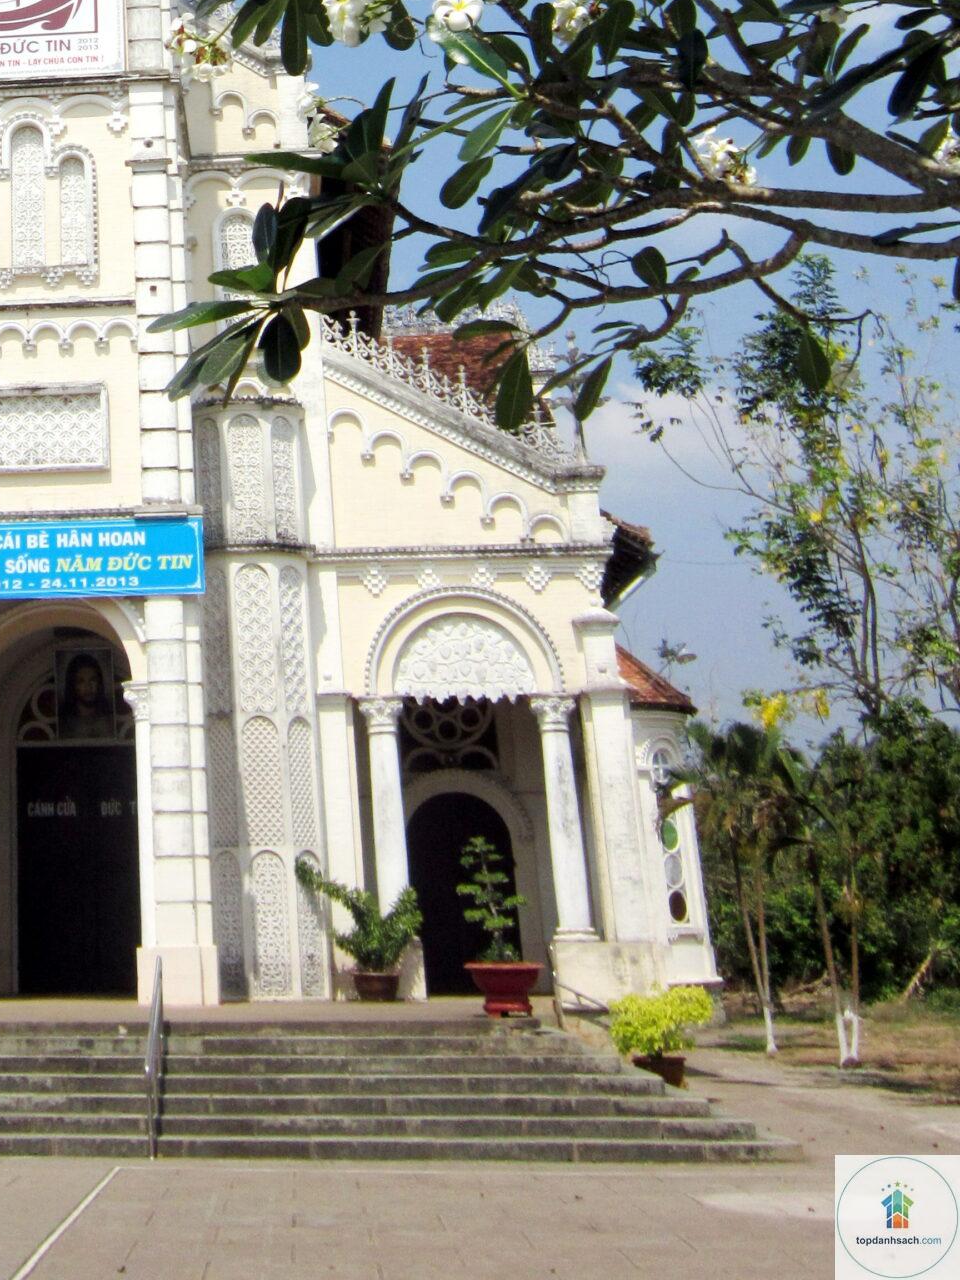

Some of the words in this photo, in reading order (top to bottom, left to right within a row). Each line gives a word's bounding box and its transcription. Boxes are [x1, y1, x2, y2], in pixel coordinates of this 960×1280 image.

[0, 38, 40, 55] ĐỨC
[45, 39, 71, 52] TIN
[77, 37, 99, 45] 2012
[7, 58, 21, 67] TIN
[67, 55, 83, 64] CON
[26, 530, 49, 549] BÈ
[56, 529, 93, 548] HÂN
[98, 531, 146, 547] HOAN
[5, 554, 50, 574] SỐNG
[55, 554, 103, 573] NĂM
[107, 552, 152, 571] ĐỨC
[157, 553, 194, 570] TIN
[41, 576, 139, 589] 24.11.2013
